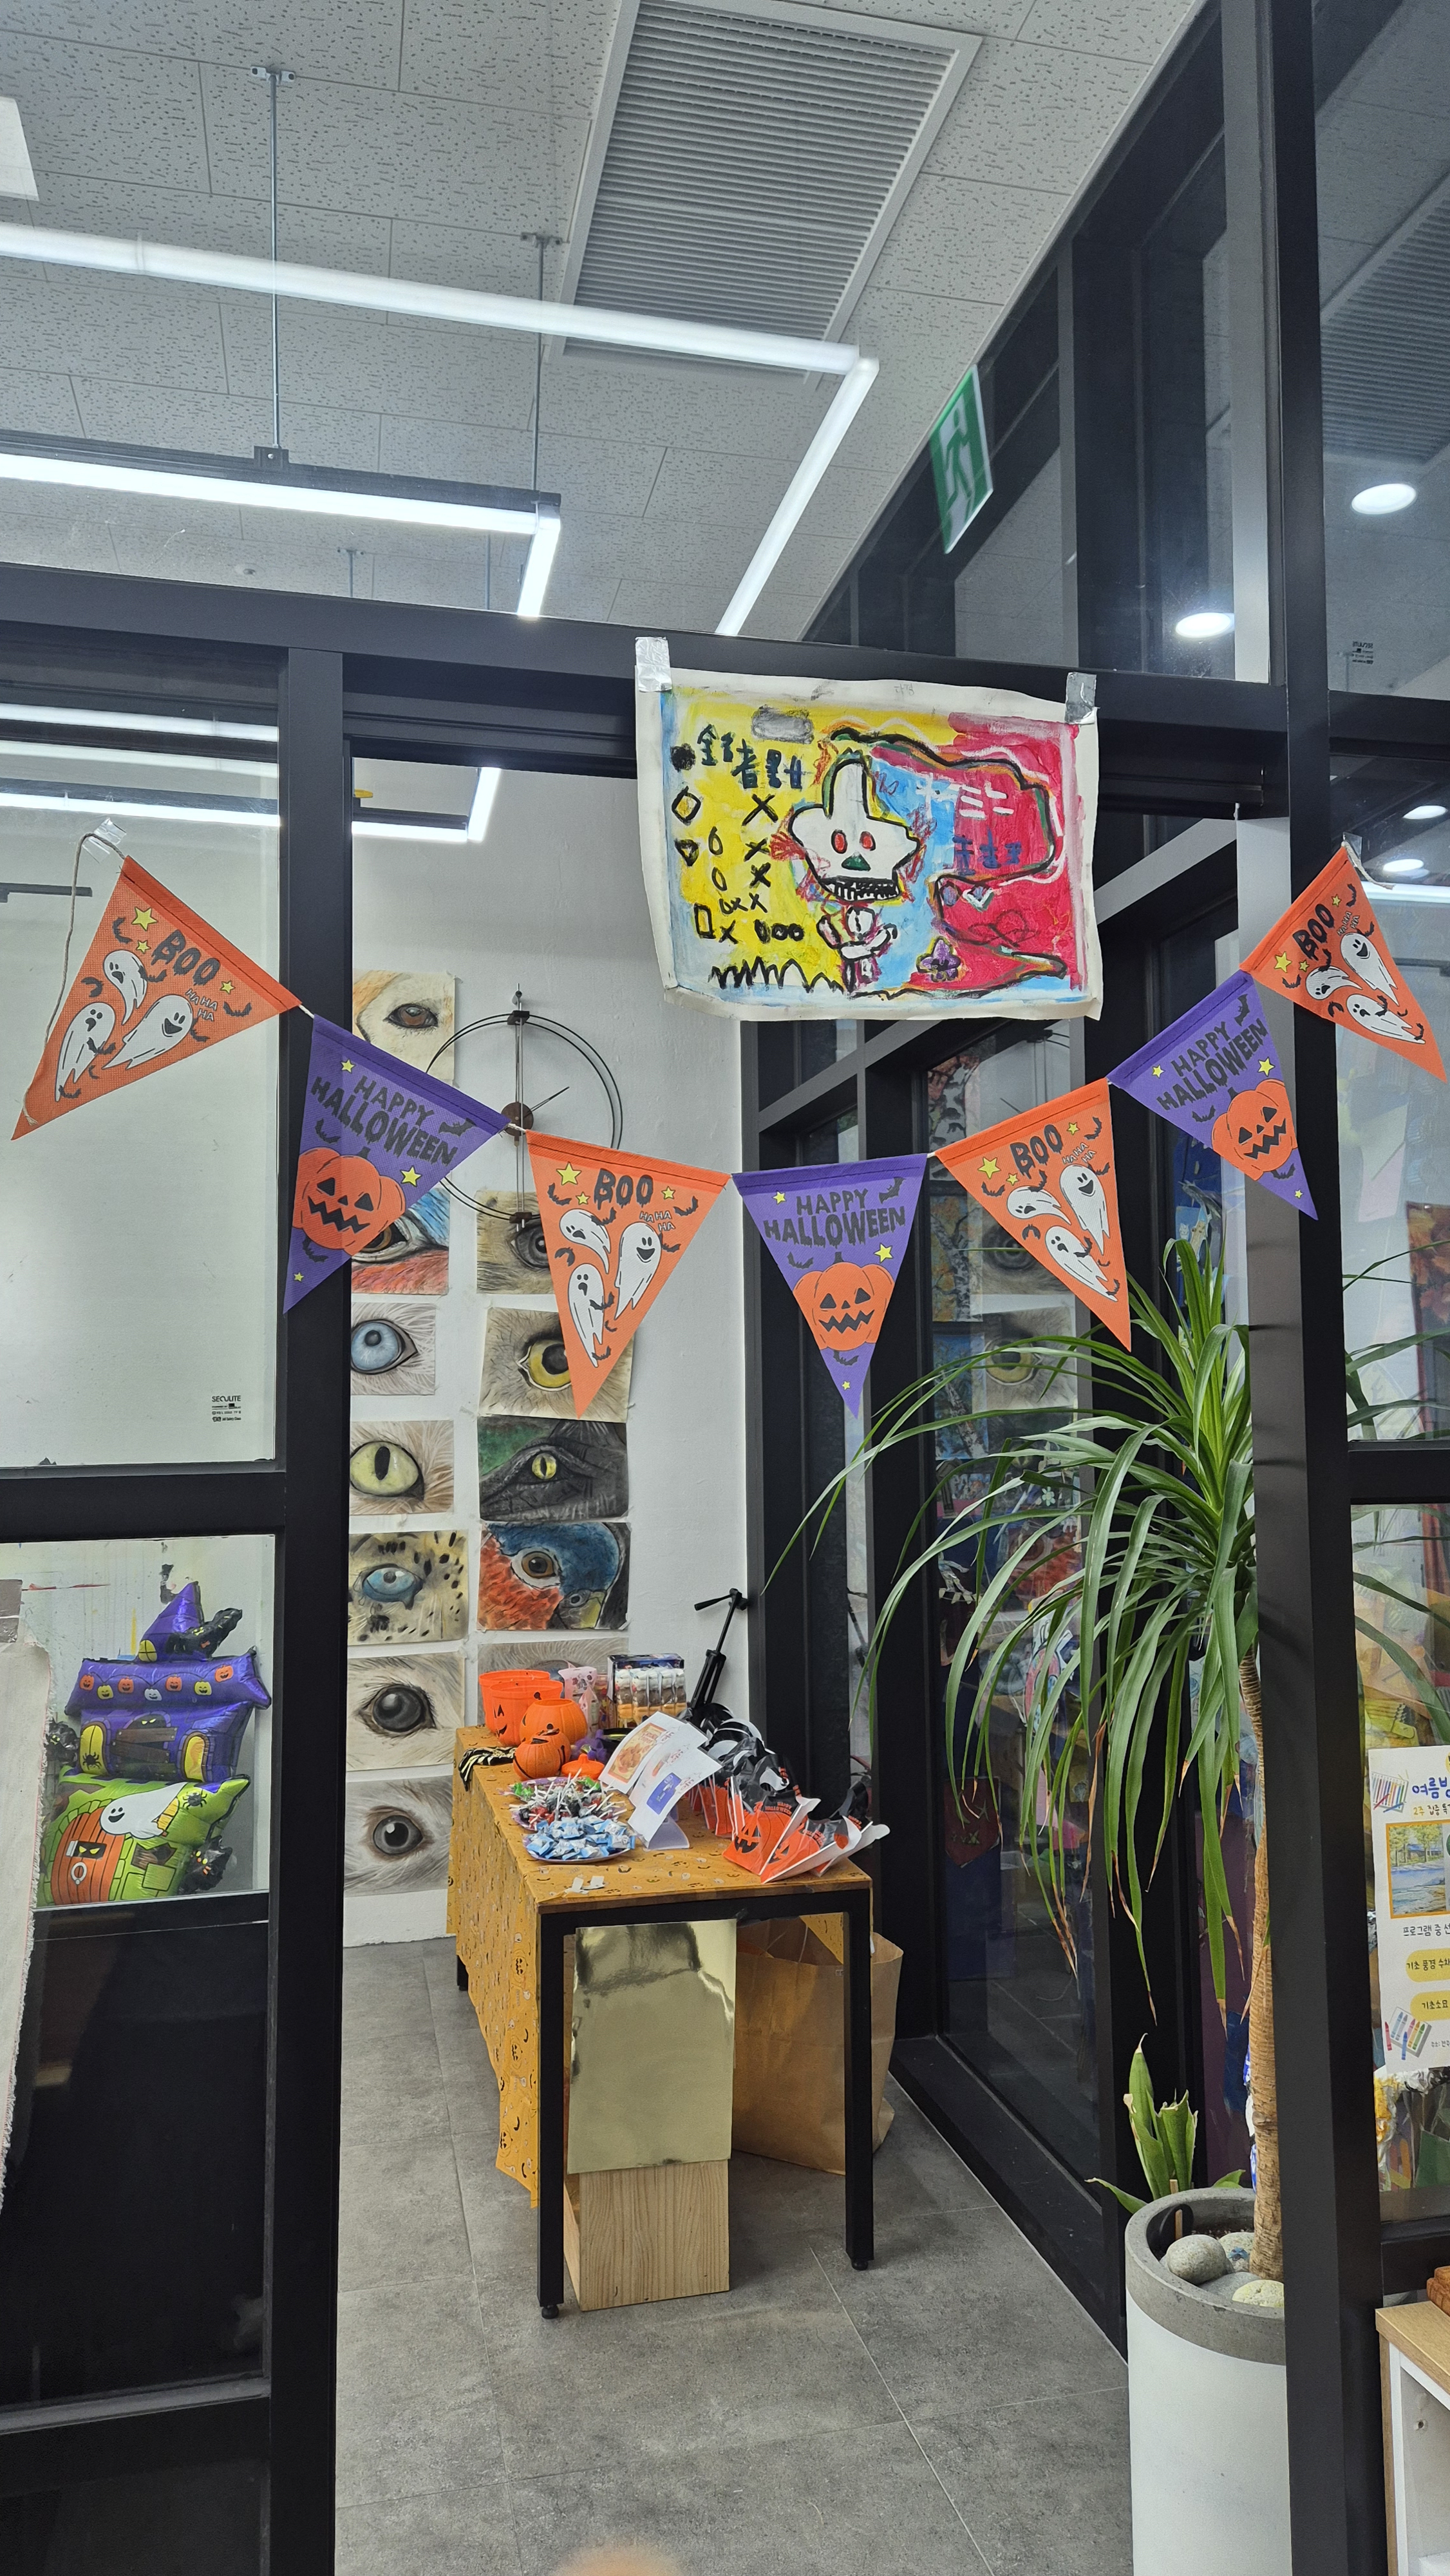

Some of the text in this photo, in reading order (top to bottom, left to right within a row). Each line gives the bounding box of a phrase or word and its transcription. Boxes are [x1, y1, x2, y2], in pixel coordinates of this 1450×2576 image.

[1292, 904, 1335, 961] BOO
[1337, 911, 1351, 936] HA HA
[1350, 915, 1360, 929] HA
[151, 929, 221, 985] BOO
[185, 989, 218, 1011] HA HA
[198, 1008, 214, 1021] HA
[1171, 1021, 1230, 1077] HAPPY
[1156, 1018, 1268, 1111] HALLOWEEN
[354, 1075, 434, 1127] HAPPY
[310, 1076, 458, 1166] HALLOWEEN
[1010, 1124, 1064, 1179] BOO
[1062, 1142, 1088, 1164] HA HA
[1082, 1150, 1097, 1163] HA
[594, 1168, 654, 1210] BOO
[796, 1188, 868, 1216] HAPPY
[639, 1211, 672, 1223] HA HA
[658, 1222, 676, 1232] HA
[763, 1206, 905, 1249] HALLOWEEN
[1413, 1803, 1450, 1815] 2주 집중 특
[1403, 1925, 1432, 1937] 프로그램
[1435, 1924, 1442, 1936] 중
[1406, 1961, 1420, 1970] 기초
[1423, 1959, 1436, 1971] 풍경
